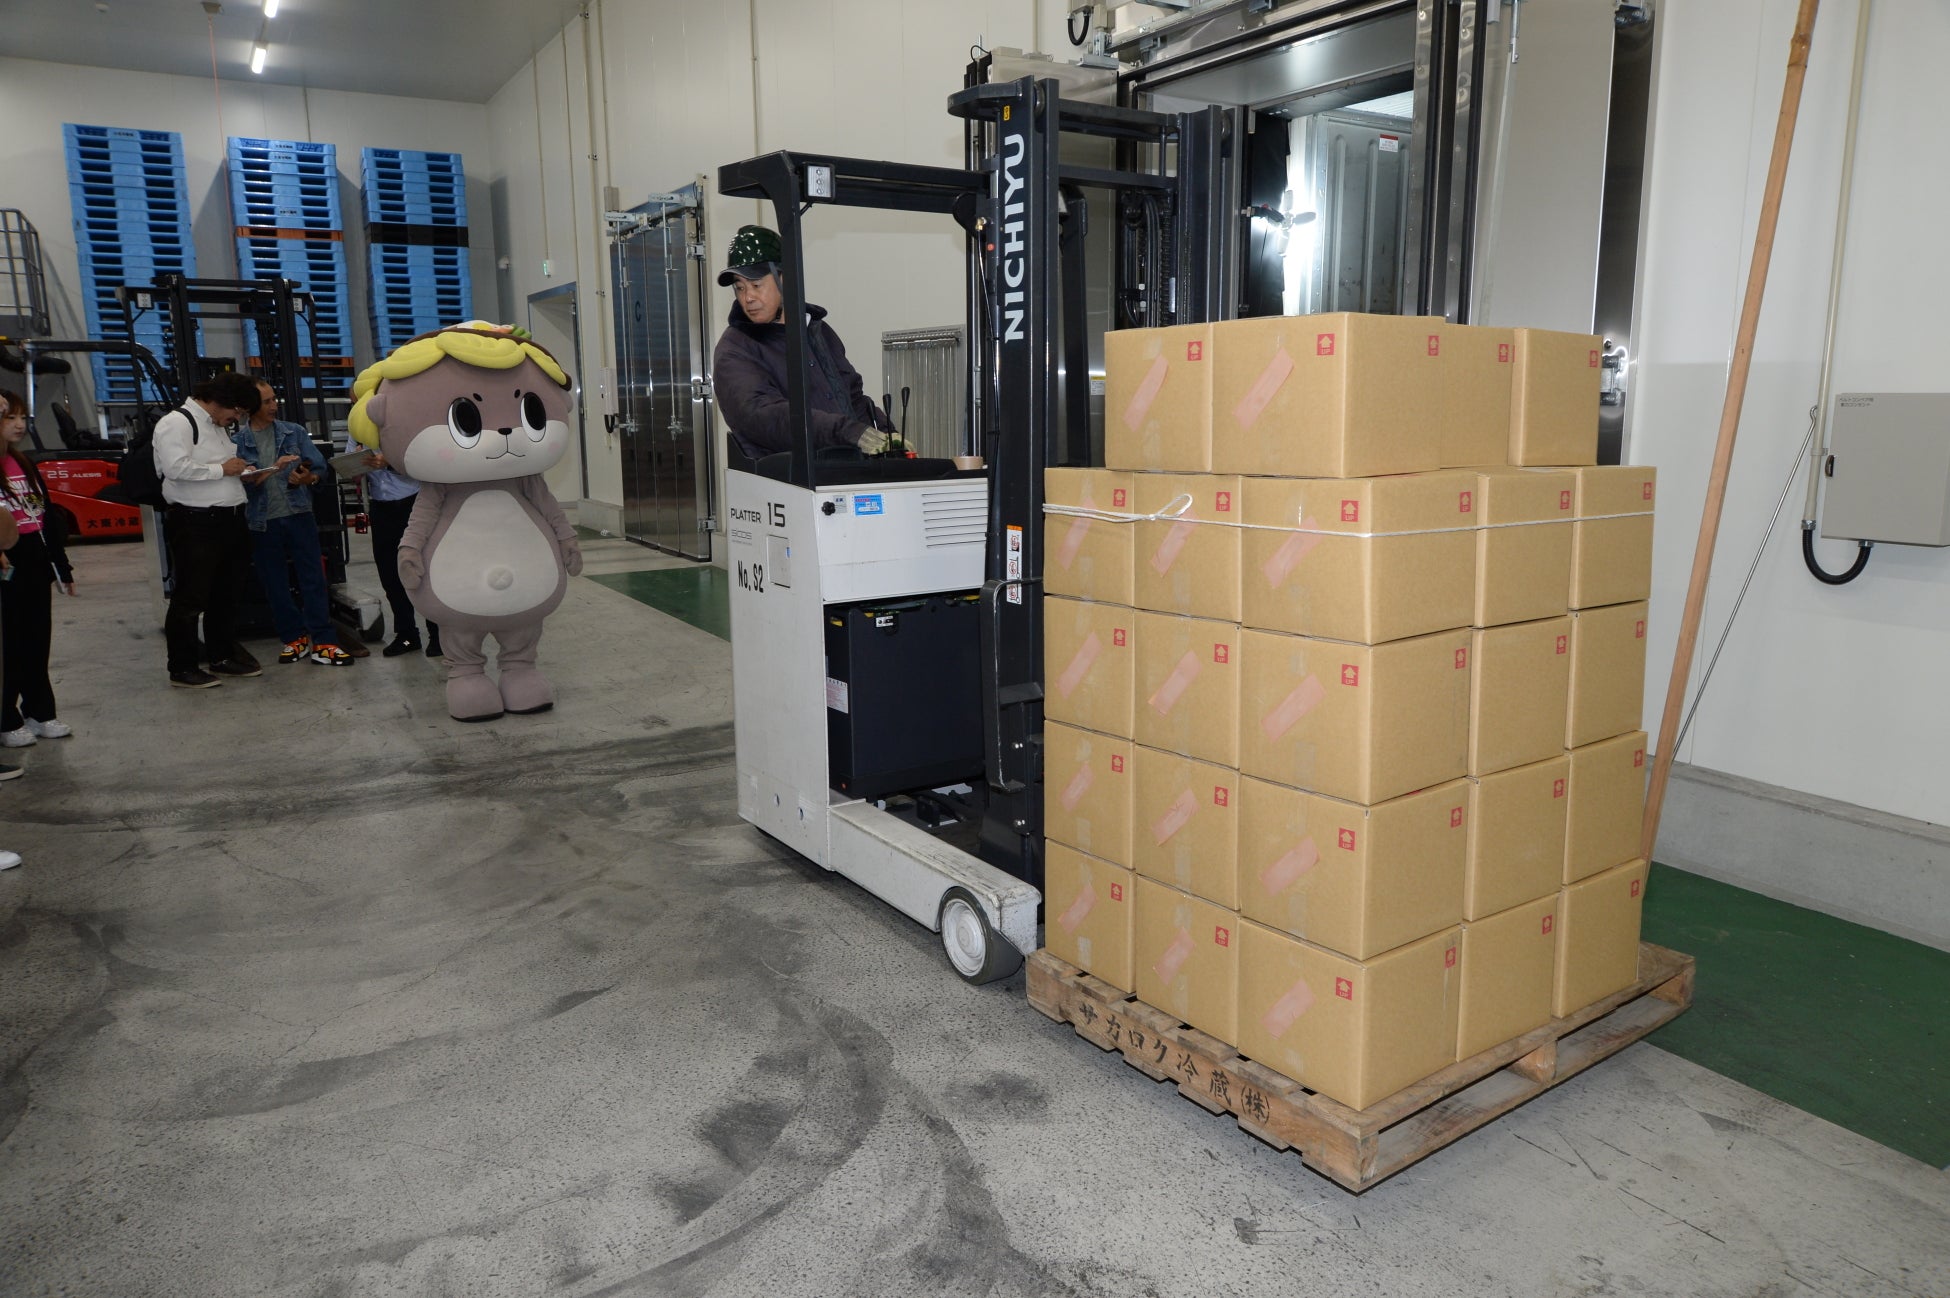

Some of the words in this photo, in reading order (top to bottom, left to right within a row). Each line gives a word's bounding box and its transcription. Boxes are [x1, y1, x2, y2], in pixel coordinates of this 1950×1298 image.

[1004, 133, 1025, 344] NICHIYU
[635, 300, 641, 322] C
[47, 470, 69, 479] 25
[730, 508, 761, 524] PLATTER
[767, 502, 785, 528] 15
[737, 560, 751, 592] No.
[753, 563, 764, 593] S2
